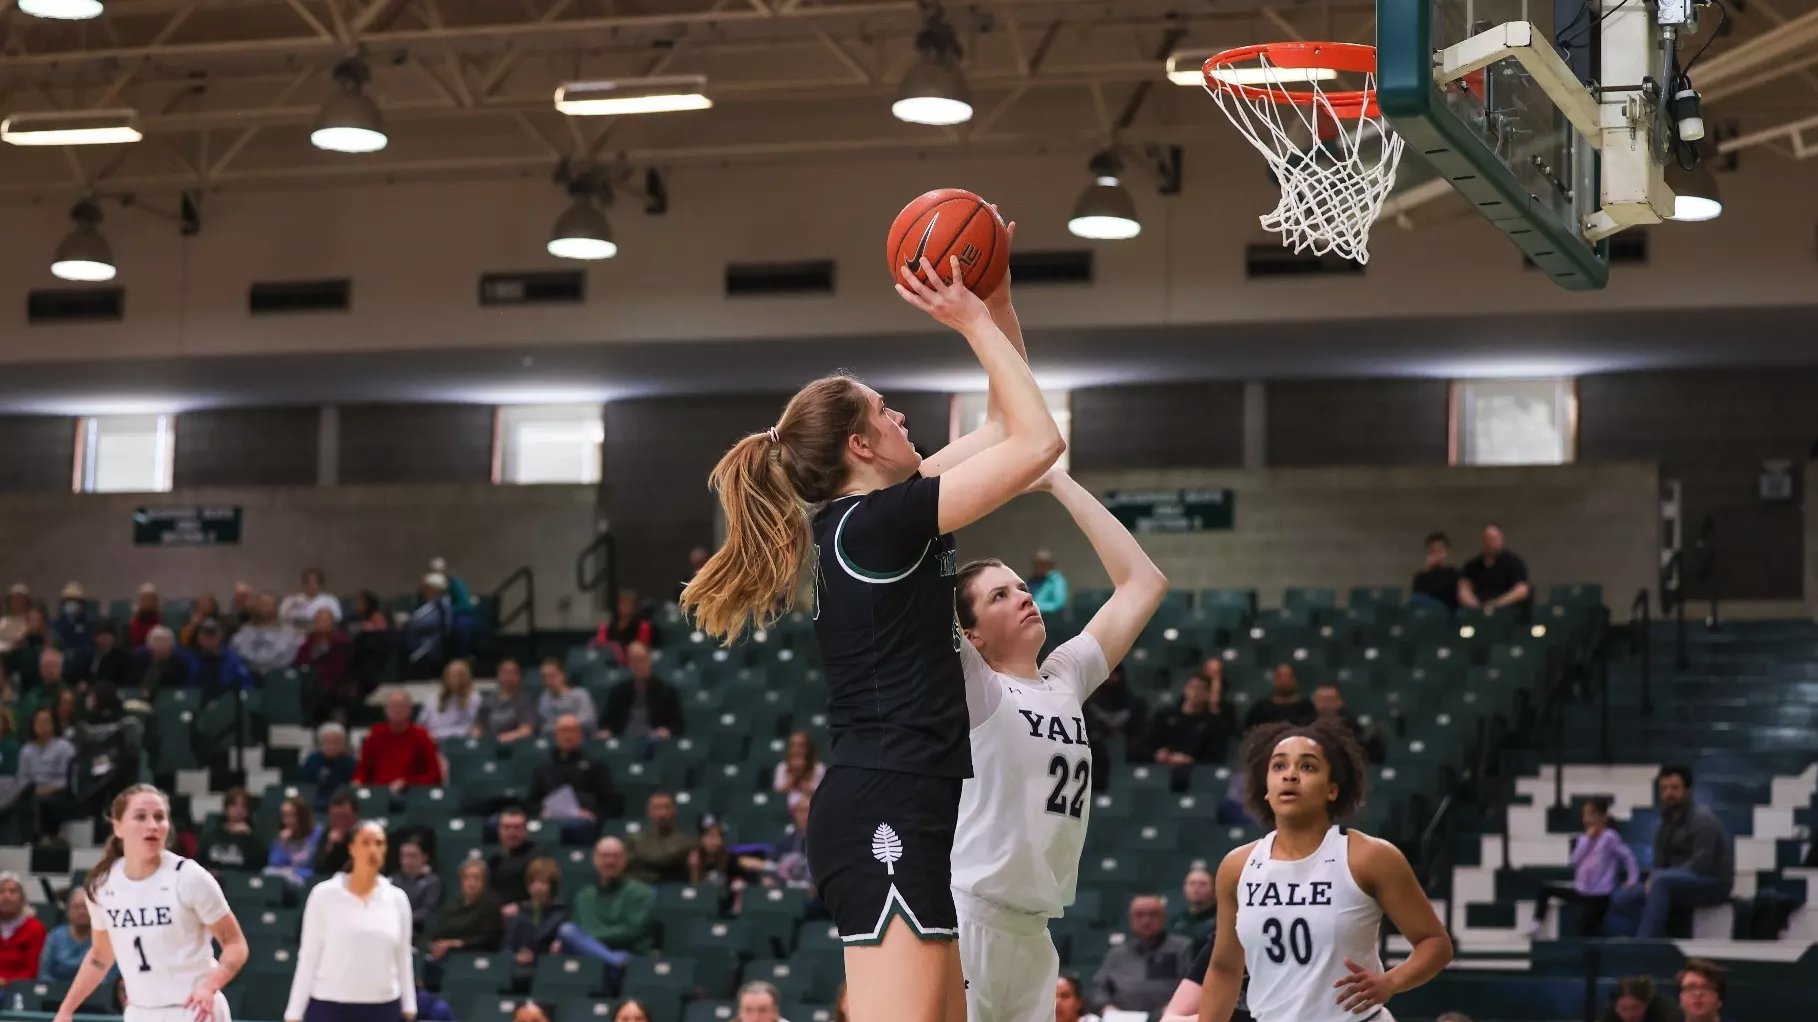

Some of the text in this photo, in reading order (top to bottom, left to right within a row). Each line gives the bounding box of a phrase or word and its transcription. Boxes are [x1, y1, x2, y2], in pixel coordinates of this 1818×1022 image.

[1019, 709, 1088, 745] YAL
[1045, 753, 1090, 818] 22
[1246, 882, 1332, 906] YALE
[107, 906, 172, 928] YALE
[133, 936, 151, 972] 1
[1262, 917, 1312, 965] 30
